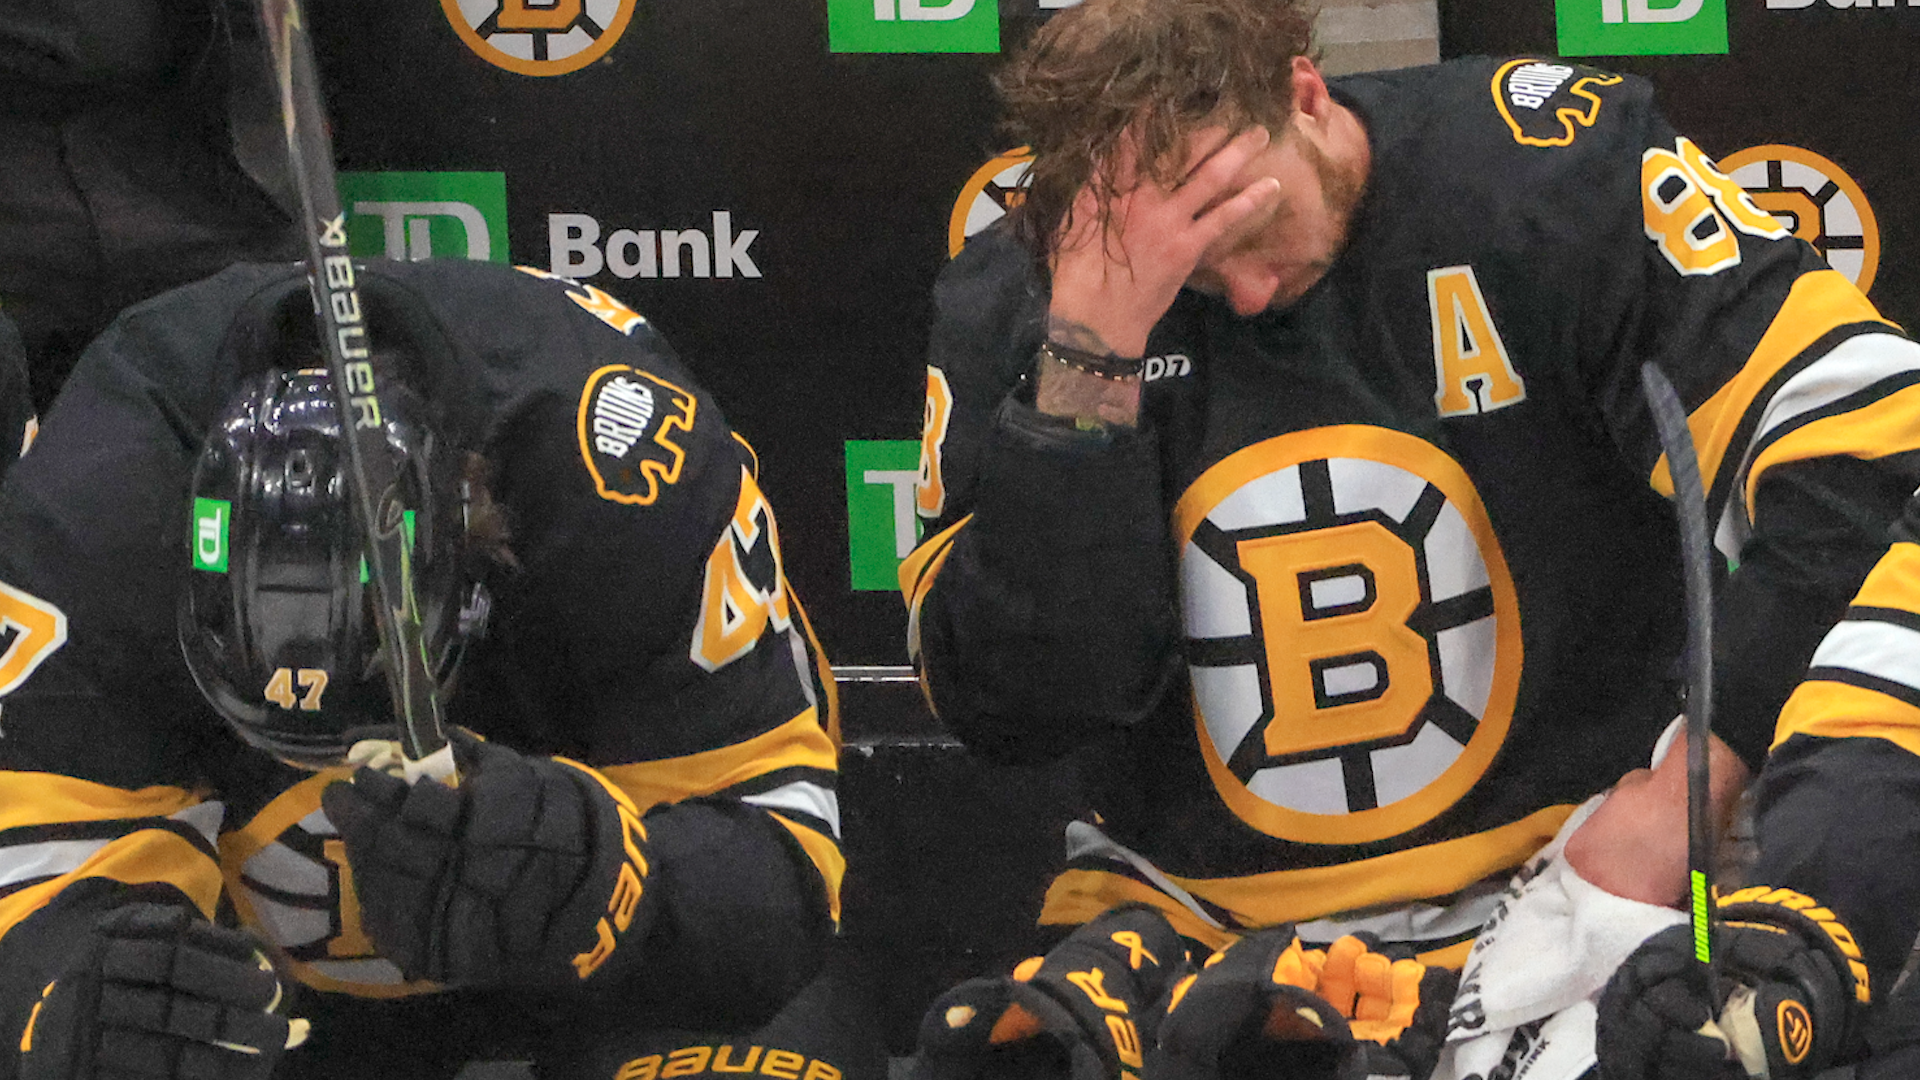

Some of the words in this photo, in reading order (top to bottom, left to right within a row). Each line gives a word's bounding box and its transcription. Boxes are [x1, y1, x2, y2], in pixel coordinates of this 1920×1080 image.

[354, 201, 490, 262] TD
[548, 210, 762, 279] Bank
[1641, 136, 1792, 277] 88
[1427, 264, 1527, 418] A
[594, 376, 654, 458] BRUINS
[198, 507, 222, 564] TD
[863, 469, 925, 559] T
[689, 463, 790, 674] 47
[1236, 520, 1433, 757] B
[263, 667, 329, 711] 47
